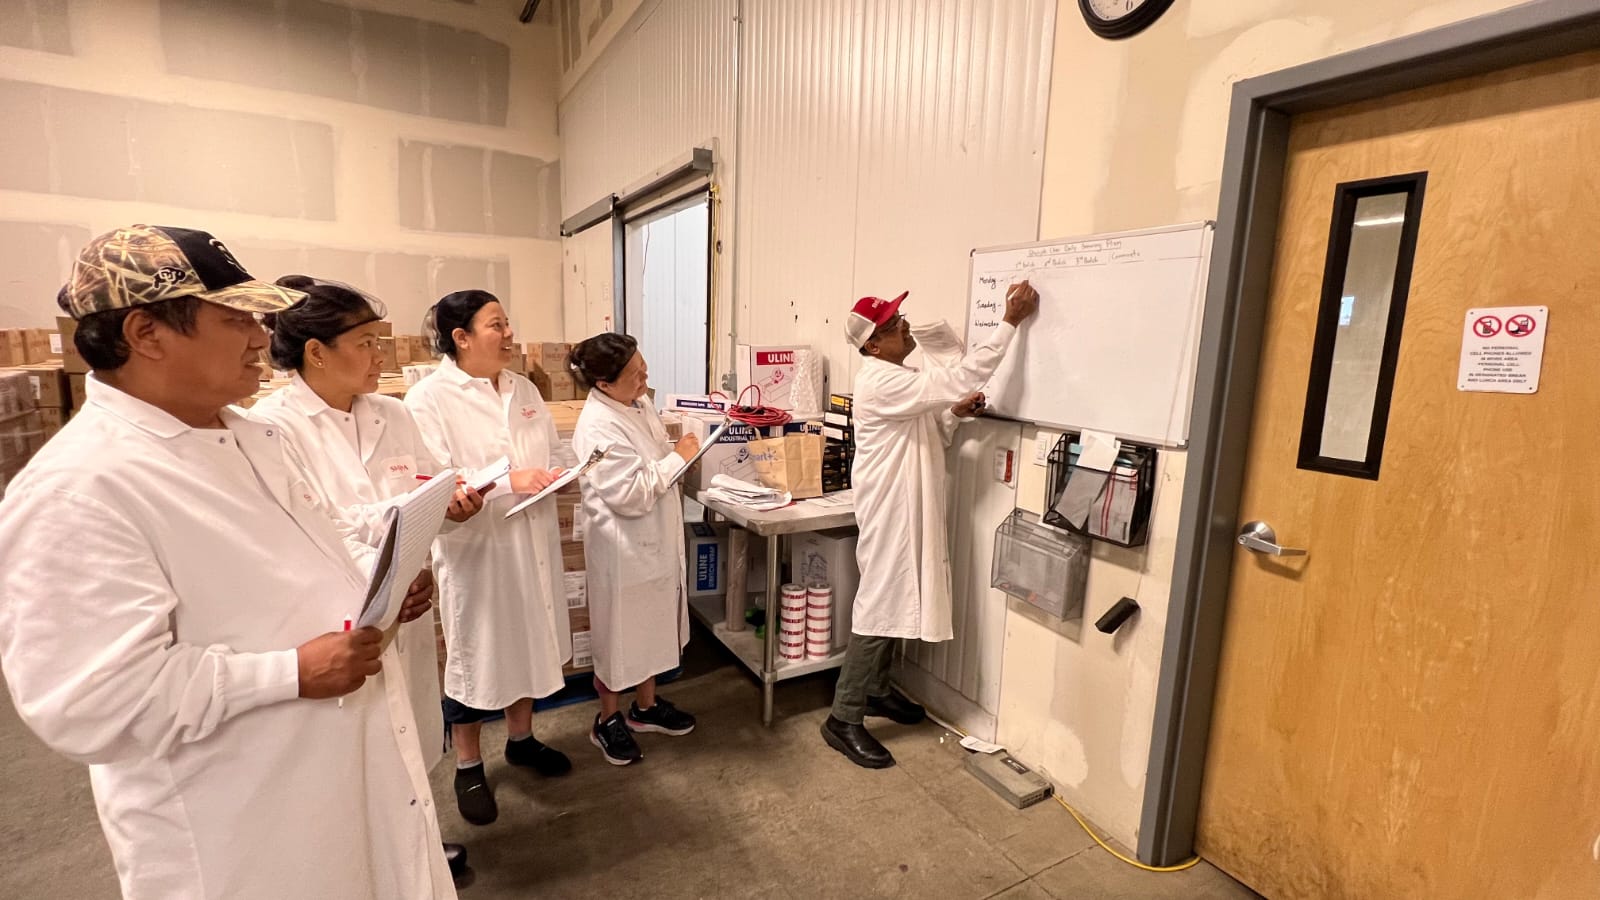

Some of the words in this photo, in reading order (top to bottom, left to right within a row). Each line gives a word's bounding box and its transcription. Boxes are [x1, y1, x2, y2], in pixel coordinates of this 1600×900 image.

[979, 276, 997, 289] Monday
[729, 426, 753, 435] ULINE
[699, 554, 708, 581] ULINE
